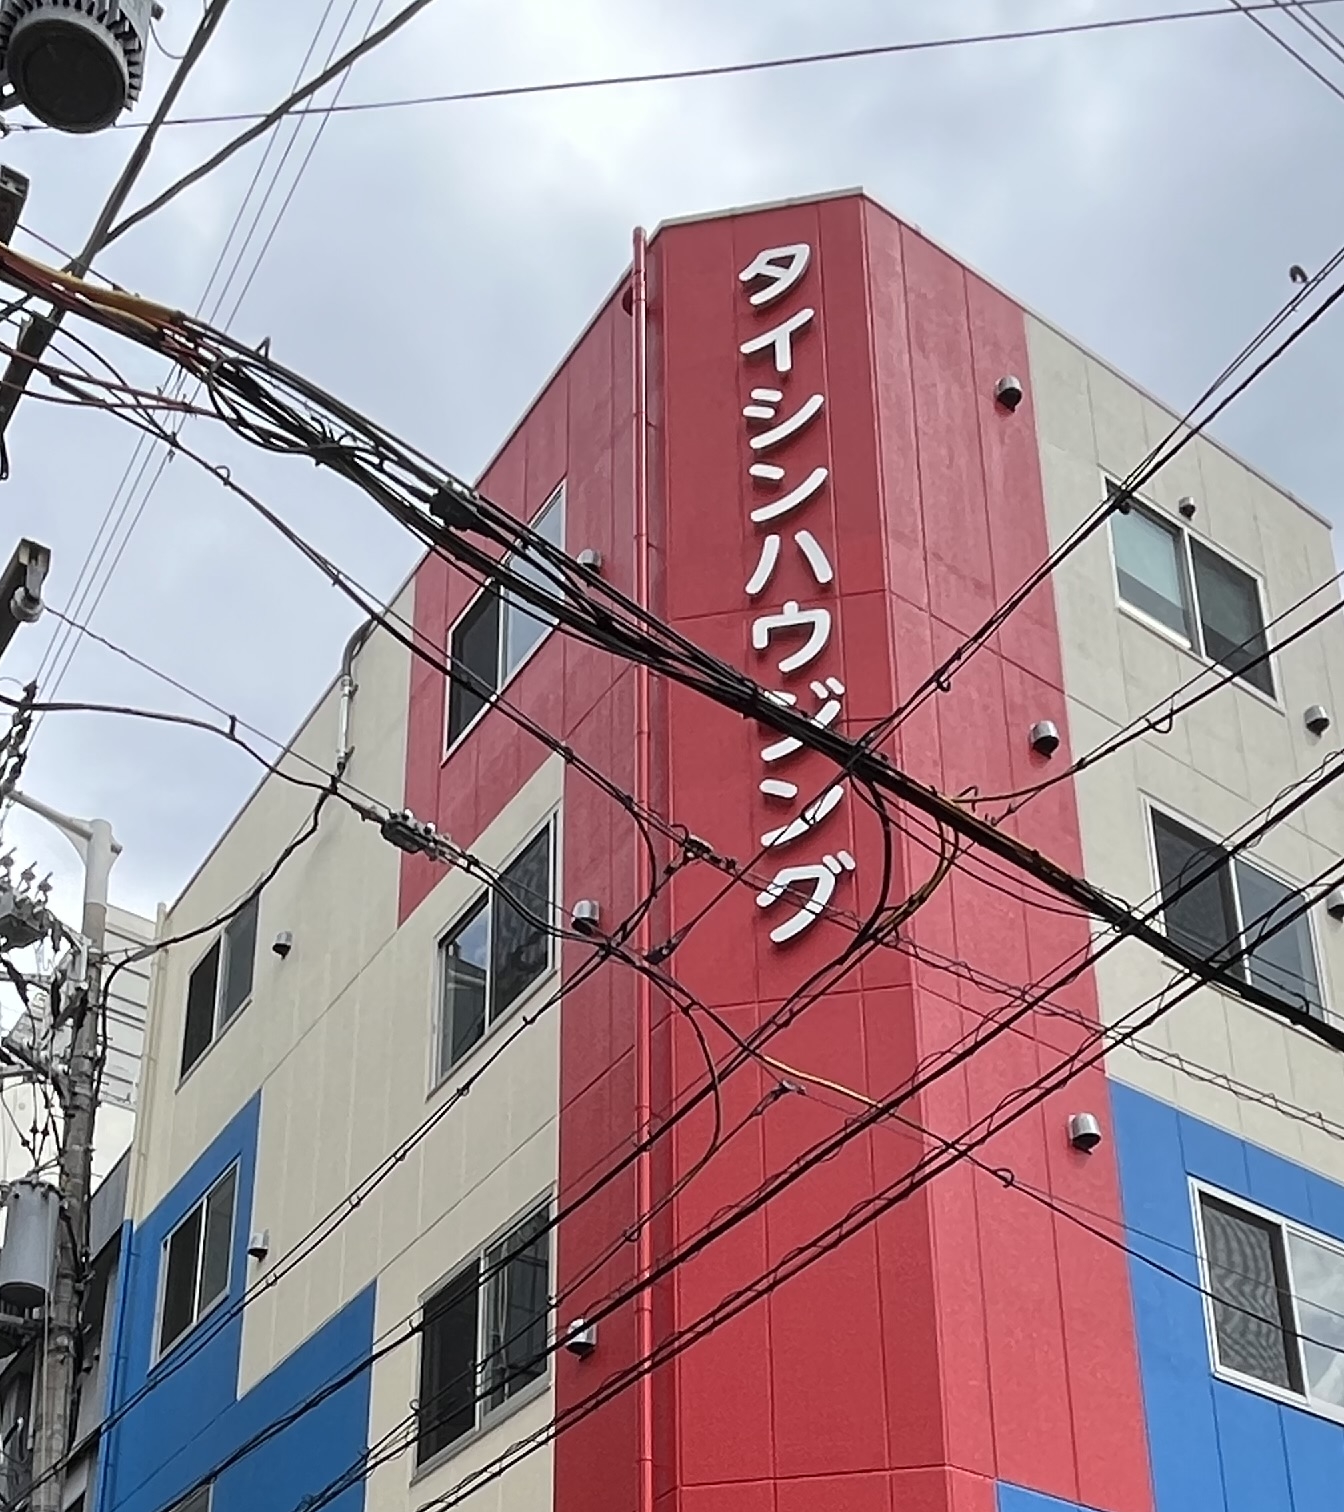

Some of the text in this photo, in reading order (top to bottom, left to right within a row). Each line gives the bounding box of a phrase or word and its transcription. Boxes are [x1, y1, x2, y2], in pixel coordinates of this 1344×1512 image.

[739, 242, 856, 945] タイシンハウジング
